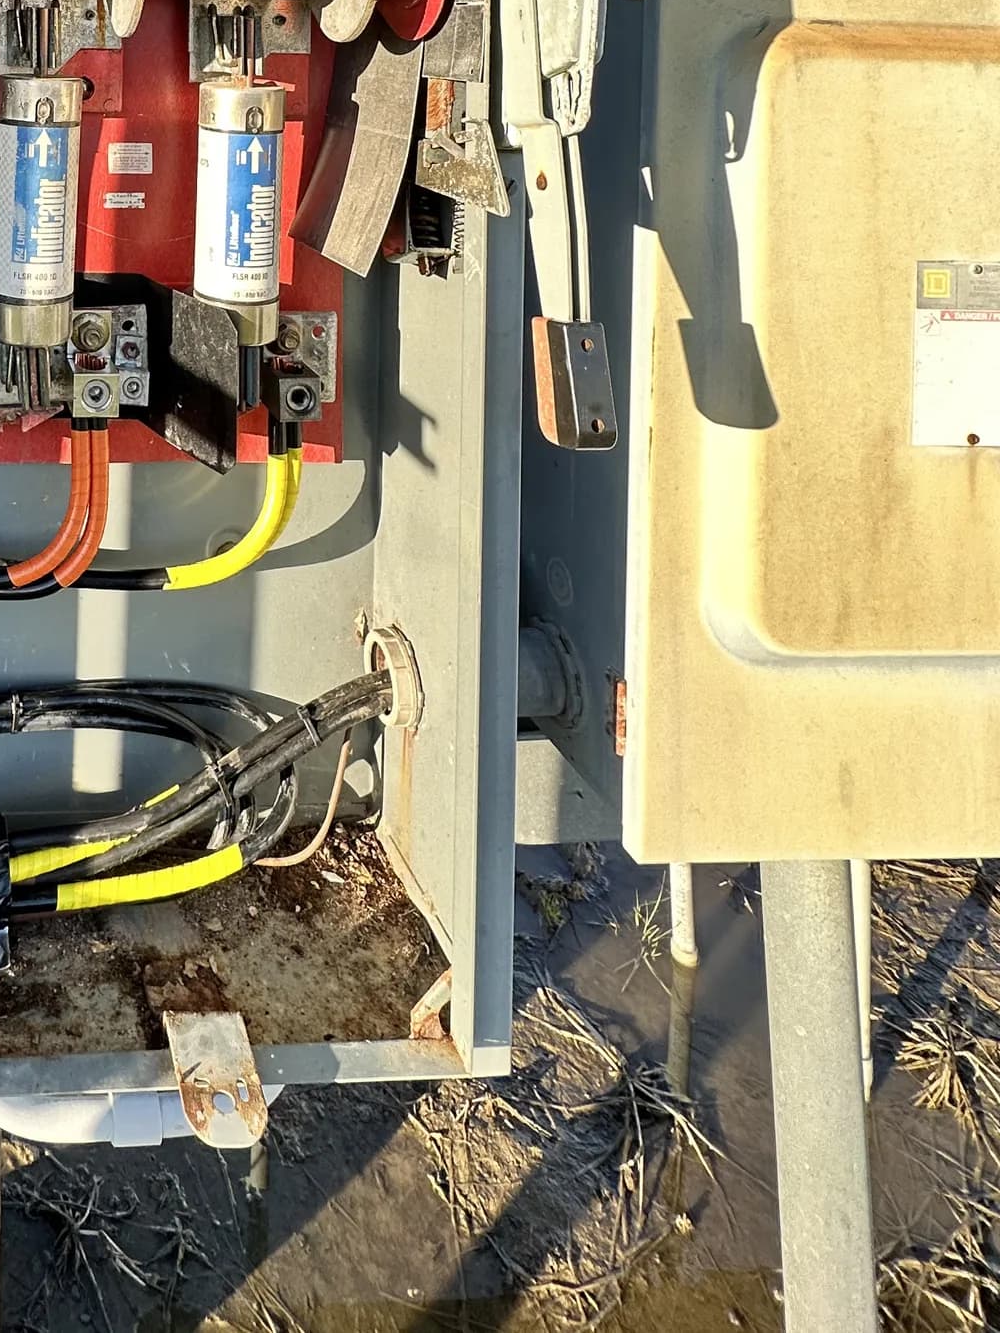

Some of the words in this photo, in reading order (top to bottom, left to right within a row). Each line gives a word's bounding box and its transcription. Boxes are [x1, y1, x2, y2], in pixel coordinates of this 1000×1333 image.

[30, 177, 66, 263] Indicator
[243, 184, 275, 267] Indicator
[13, 271, 32, 281] FLSR
[232, 272, 249, 281] FLSR
